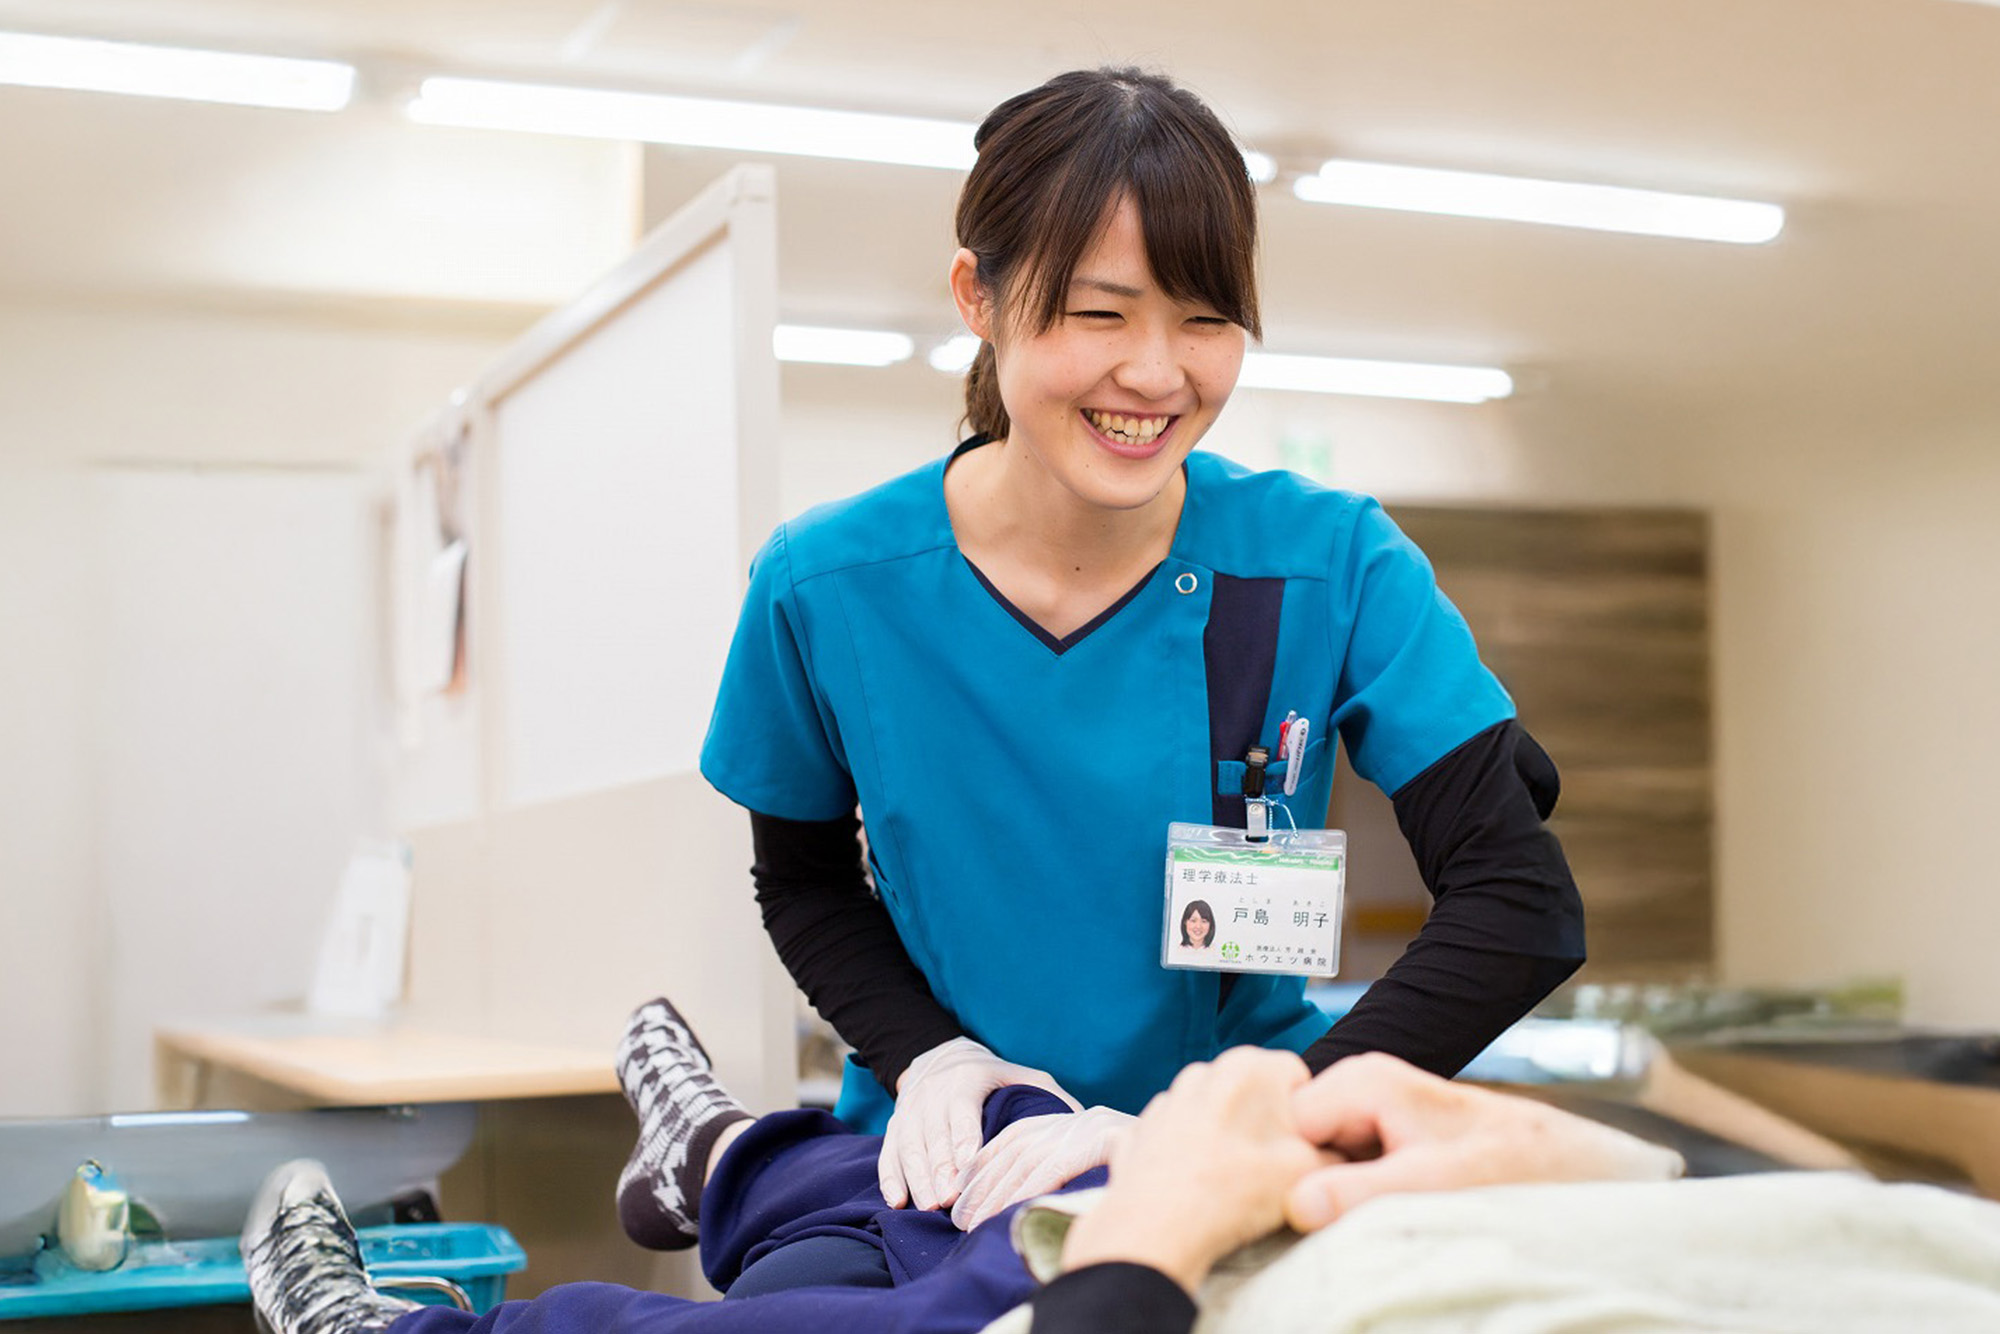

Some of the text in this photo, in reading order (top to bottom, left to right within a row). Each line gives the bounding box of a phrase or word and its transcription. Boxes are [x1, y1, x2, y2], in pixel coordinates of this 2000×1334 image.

[1182, 868, 1259, 885] 理学療法士
[1232, 907, 1329, 928] 戸島 明子
[1245, 954, 1327, 967] ホウエツ病院
